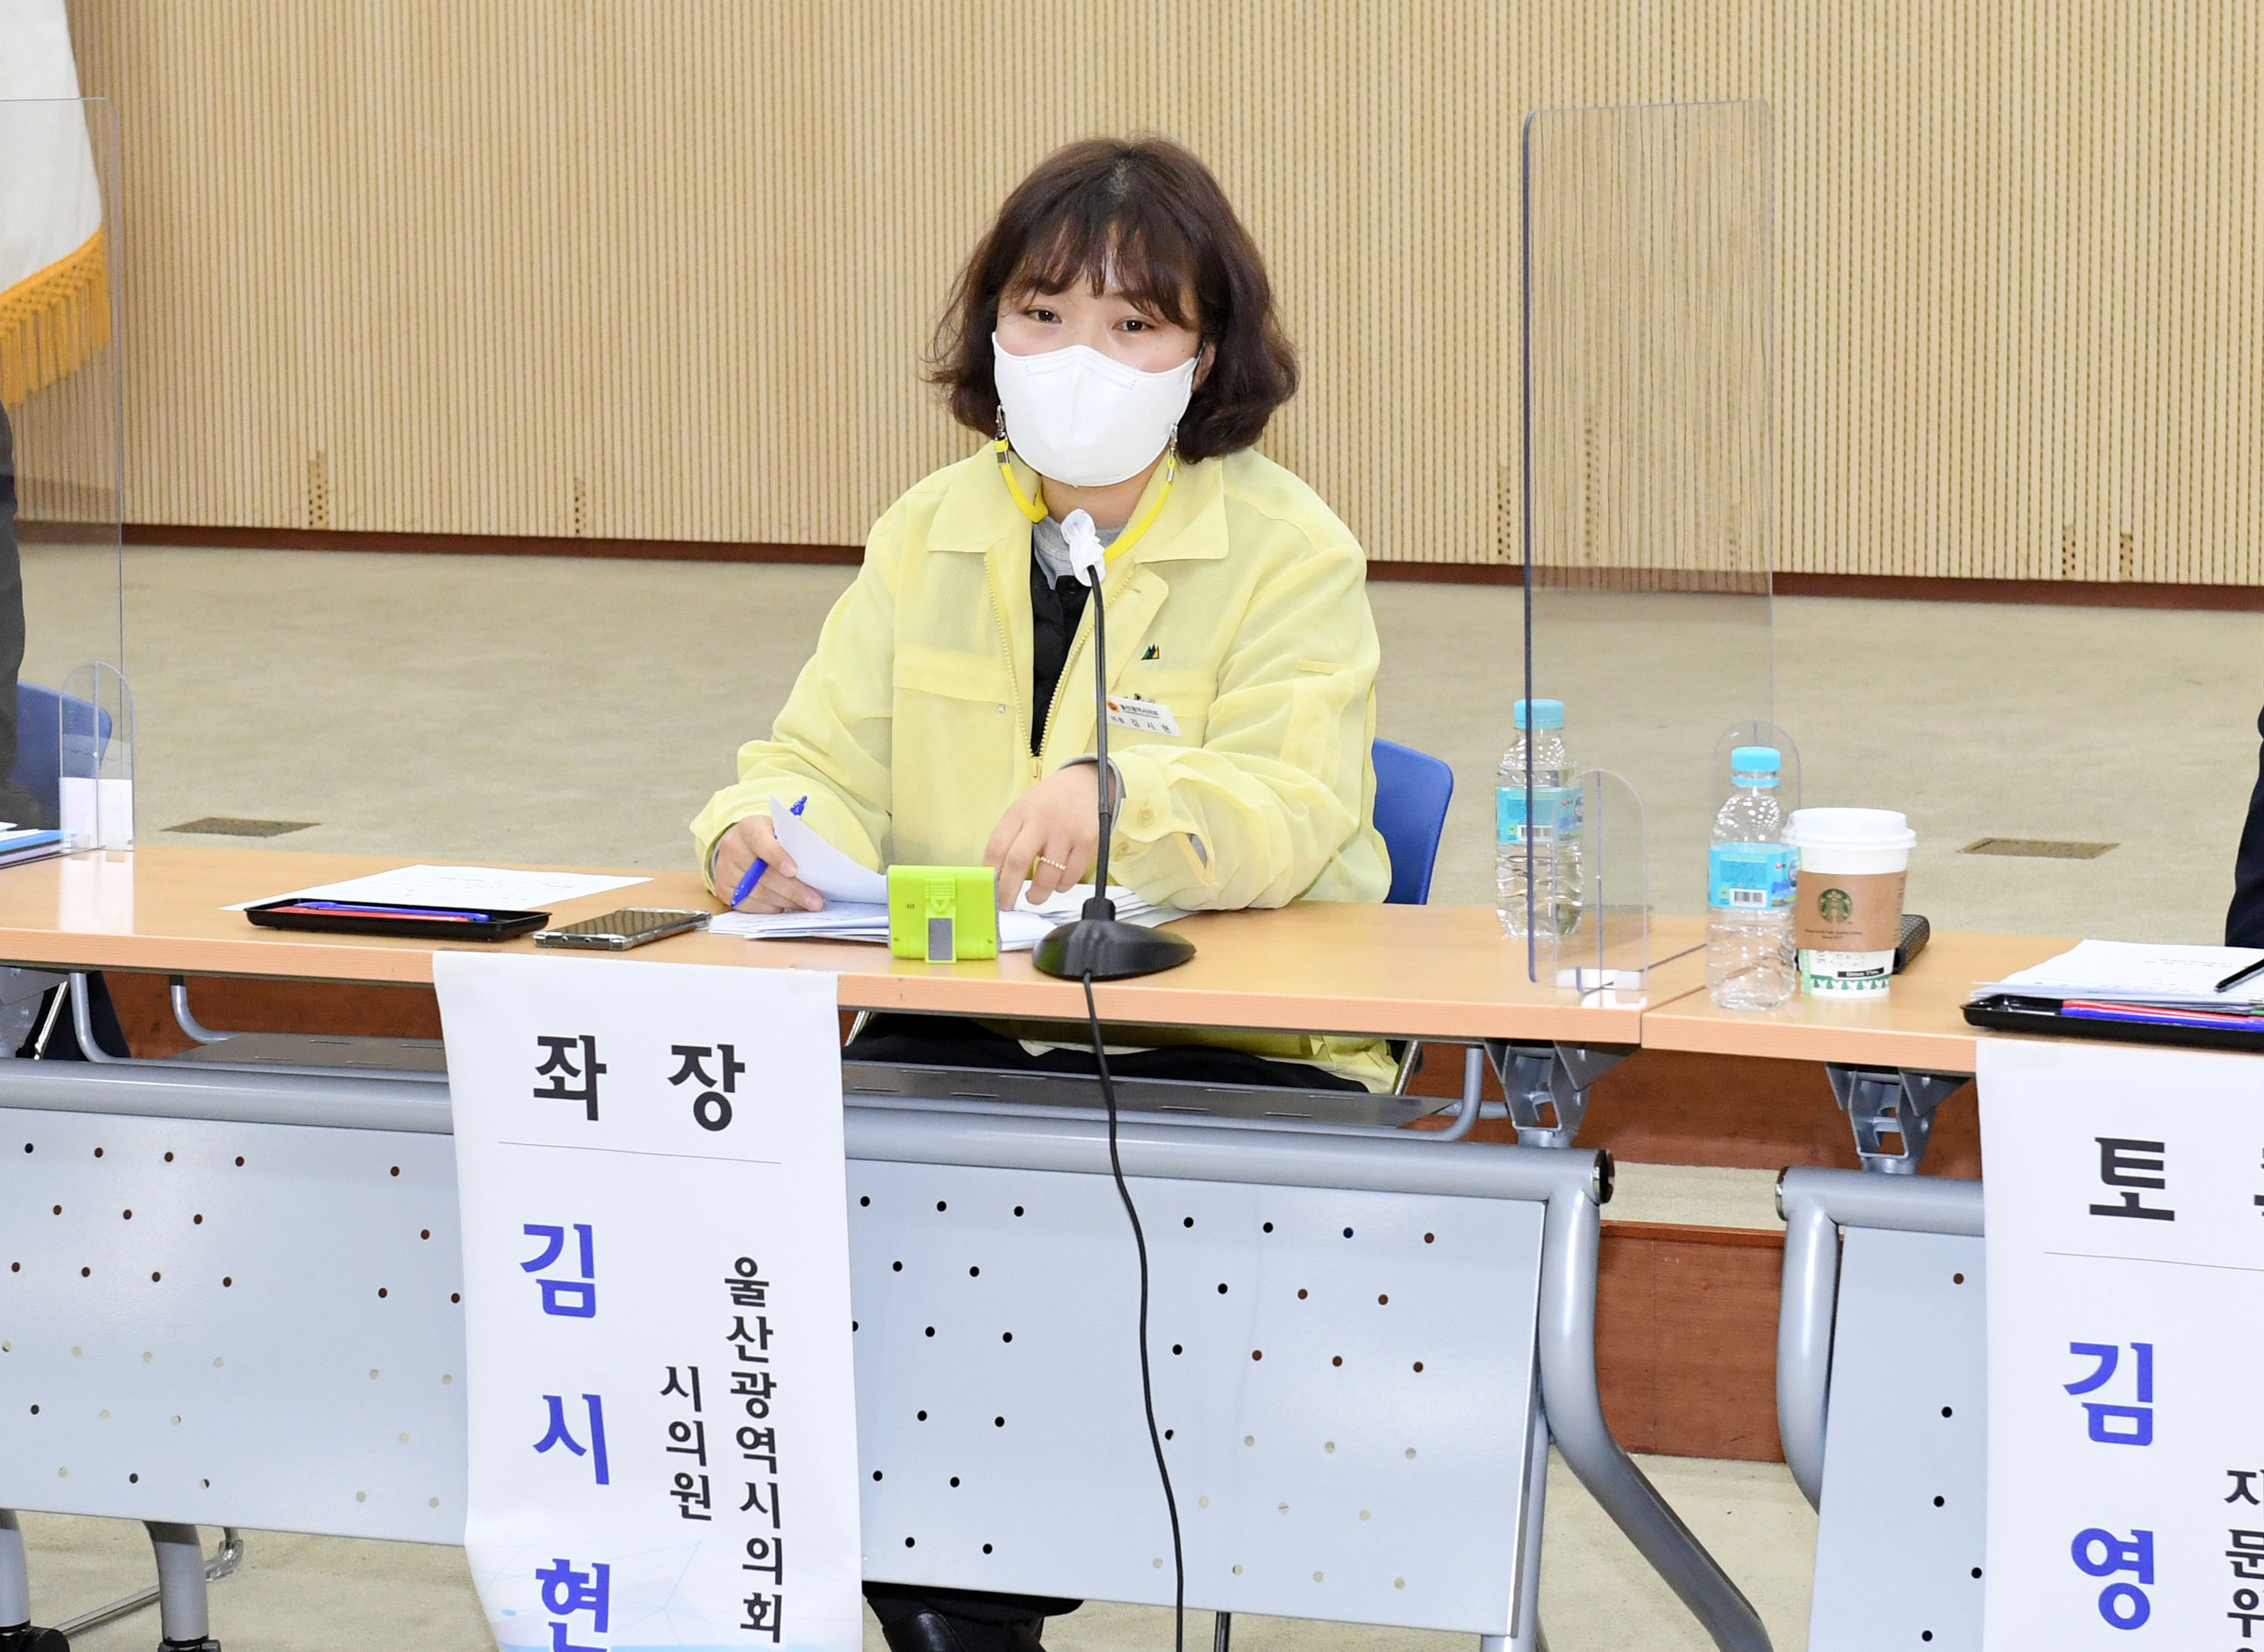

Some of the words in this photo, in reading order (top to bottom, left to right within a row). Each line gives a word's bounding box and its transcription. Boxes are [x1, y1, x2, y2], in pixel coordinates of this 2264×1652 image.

[2089, 1137, 2264, 1221] 토
[660, 1365, 713, 1521] 시의원
[724, 1256, 783, 1644] 울산광역시의회
